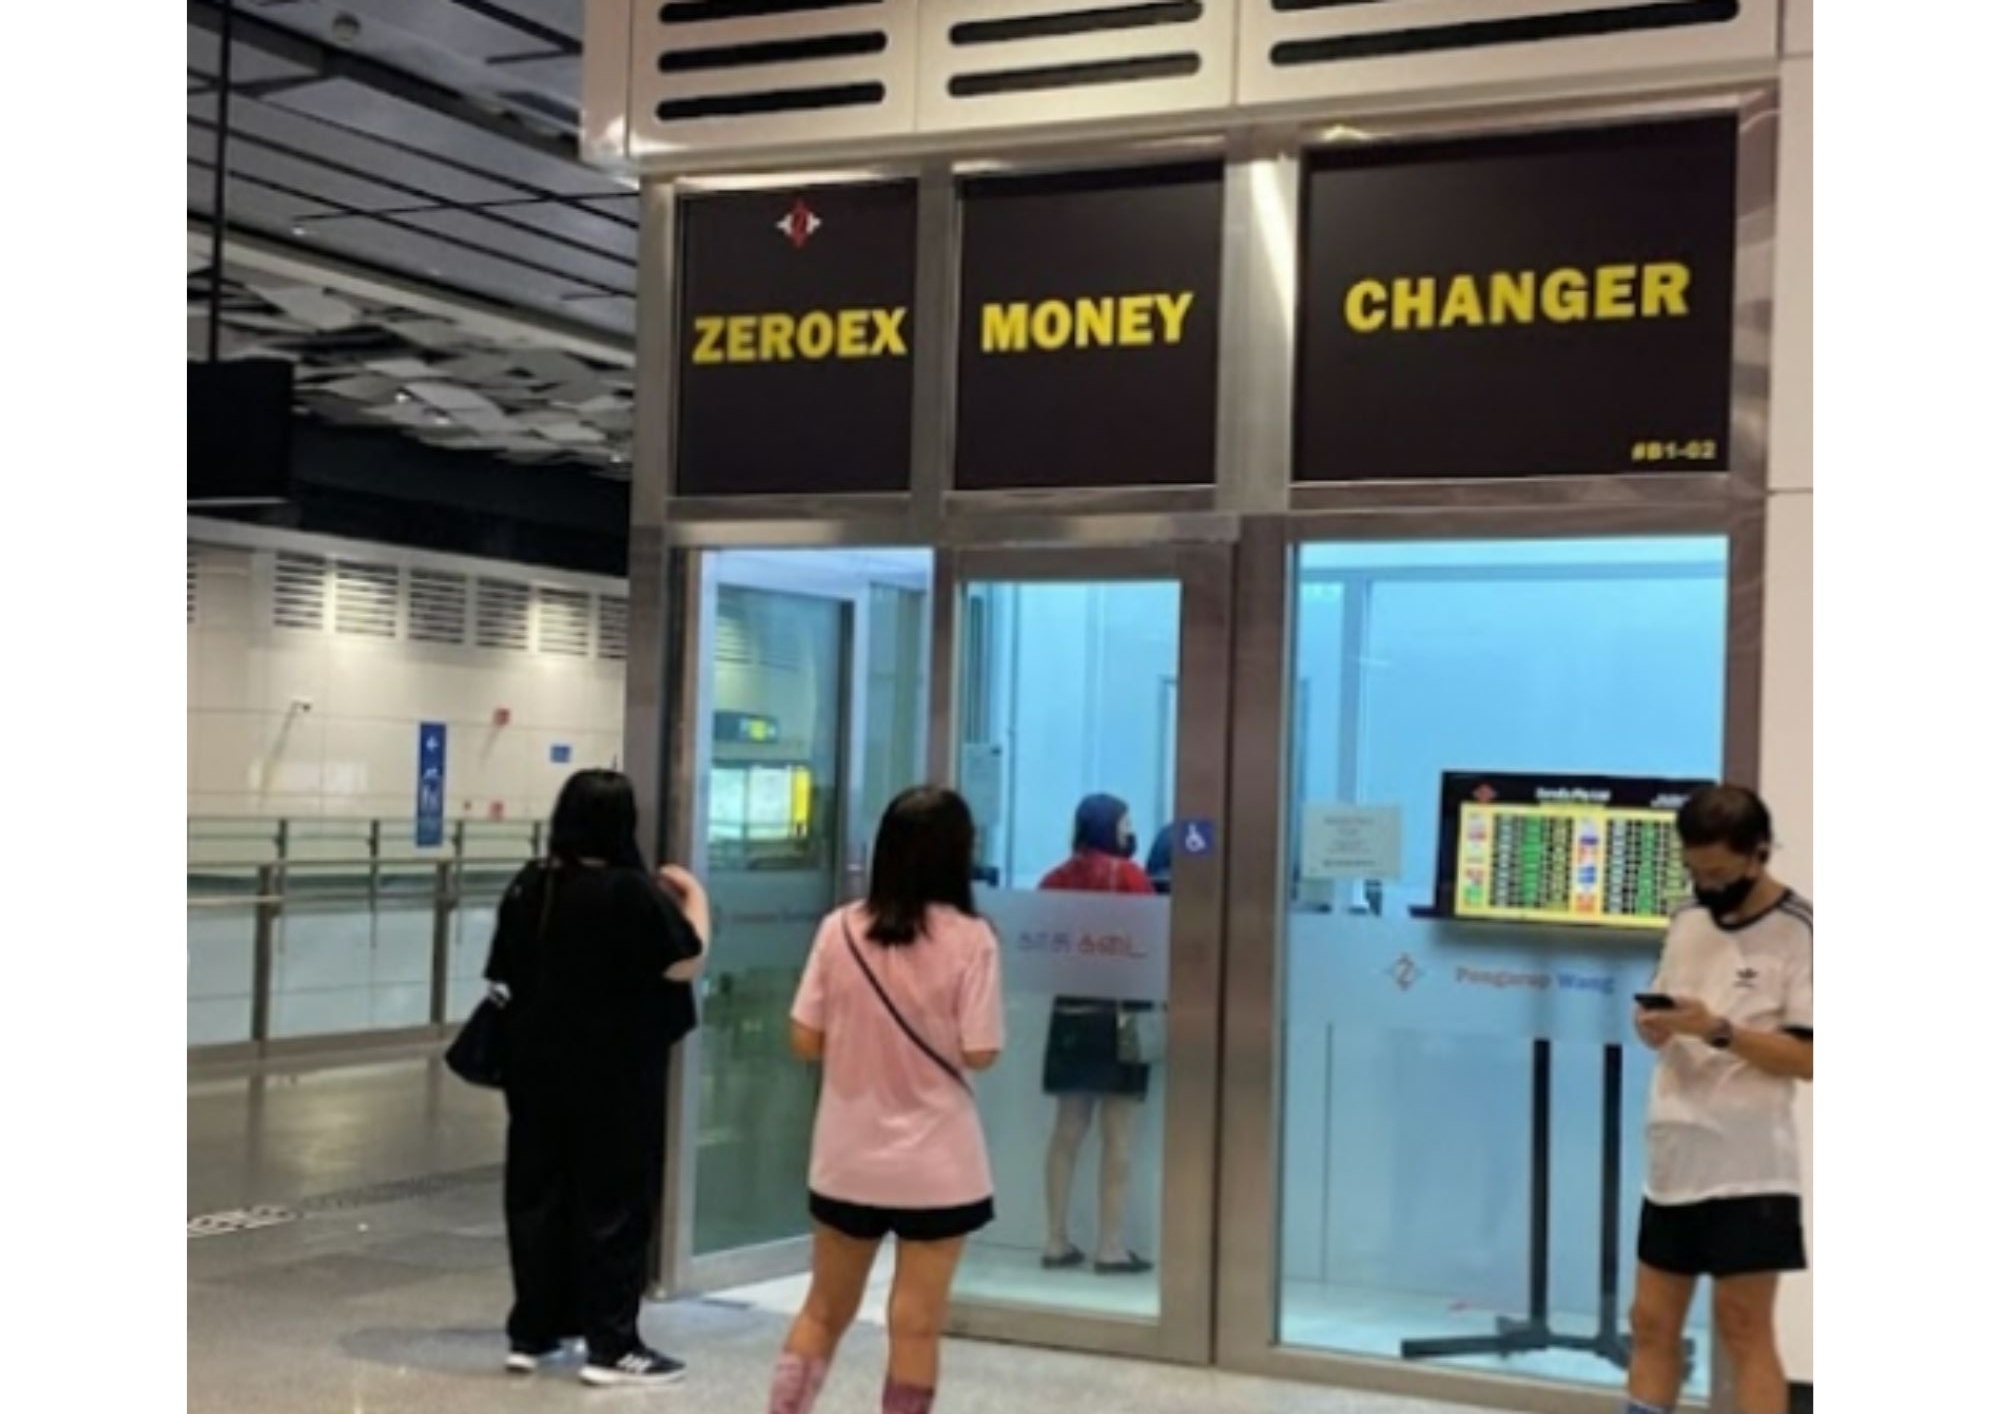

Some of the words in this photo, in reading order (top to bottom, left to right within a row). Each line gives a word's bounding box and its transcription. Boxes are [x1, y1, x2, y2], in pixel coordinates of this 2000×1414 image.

[692, 307, 908, 364] ZEROEX
[981, 292, 1194, 352] MONEY
[1344, 261, 1690, 332] CHANGER
[1631, 440, 1717, 461] #B1-02
